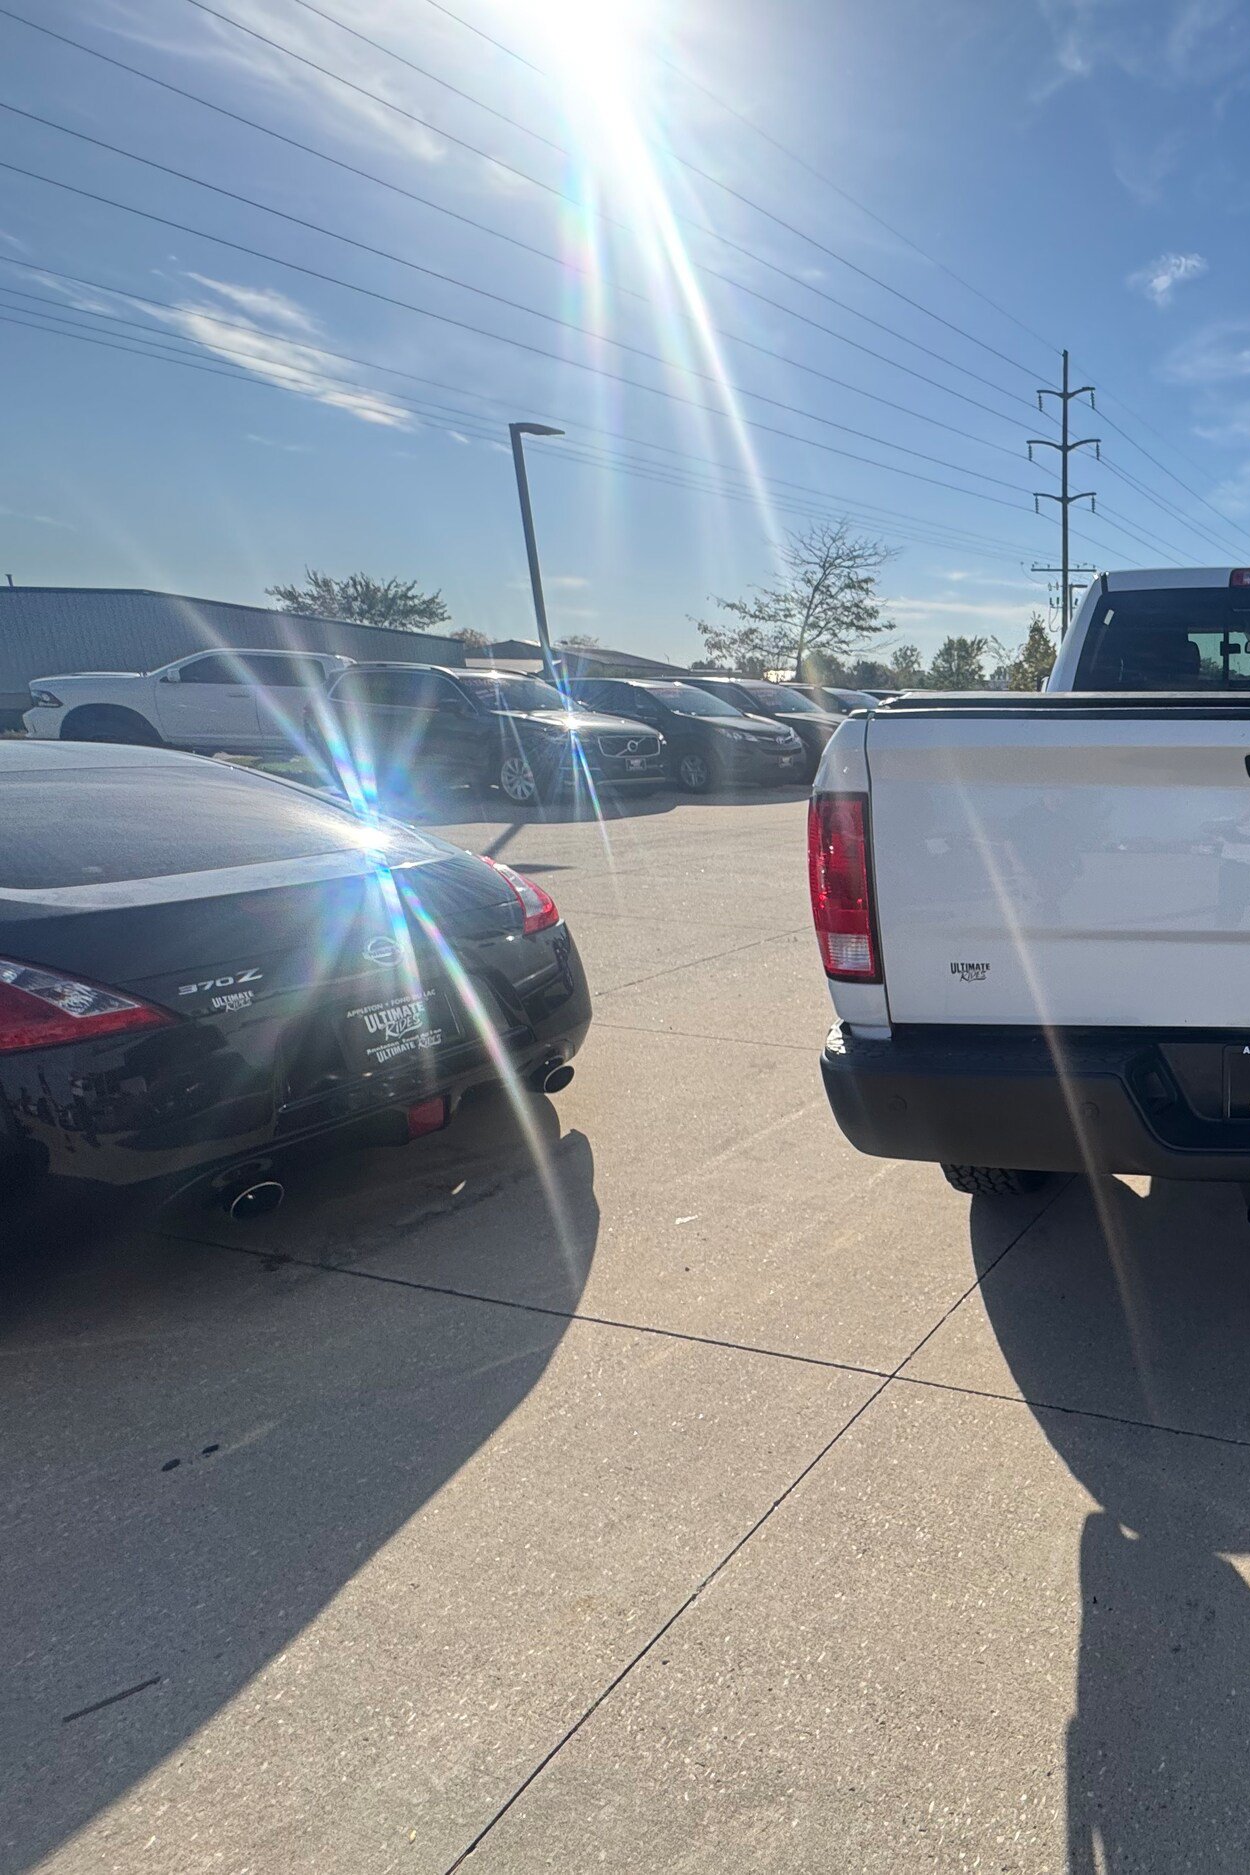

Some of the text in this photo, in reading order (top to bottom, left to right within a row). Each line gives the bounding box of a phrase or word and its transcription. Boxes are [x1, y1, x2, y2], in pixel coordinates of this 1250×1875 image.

[950, 962, 991, 975] ULTIMATE
[211, 990, 254, 1009] ULTIMATE
[345, 1002, 384, 1018] APPLETON
[363, 1001, 425, 1034] ULTIMATE
[384, 1012, 423, 1041] RIDES
[375, 1040, 416, 1063] ULTIMATE
